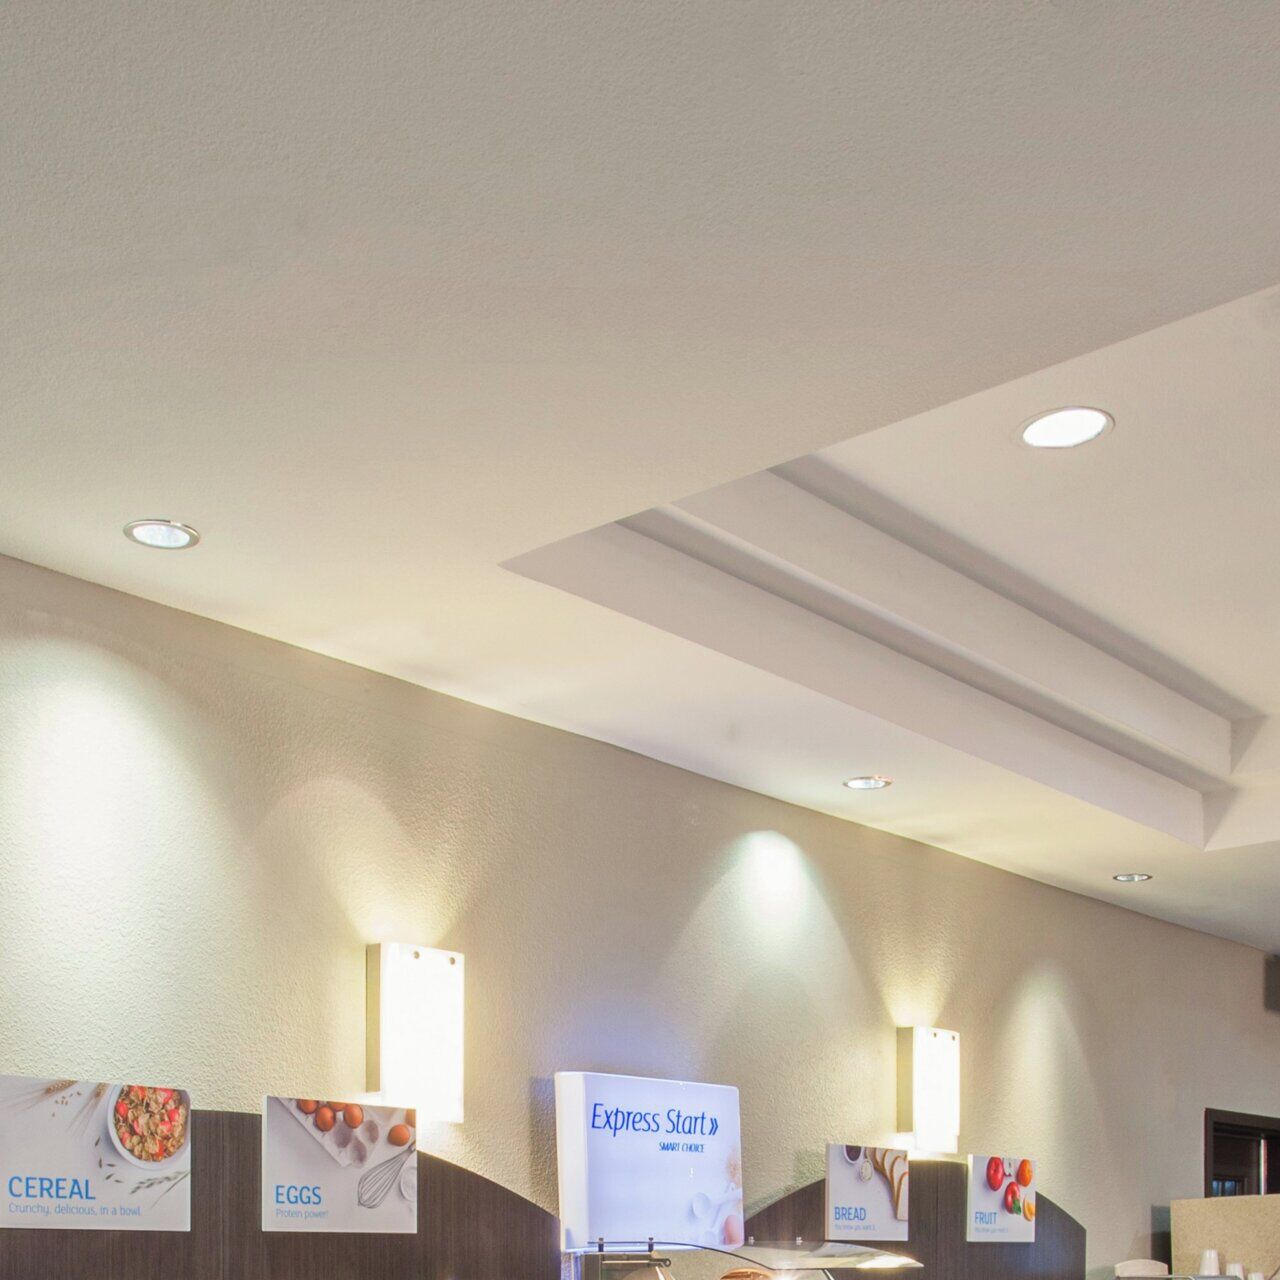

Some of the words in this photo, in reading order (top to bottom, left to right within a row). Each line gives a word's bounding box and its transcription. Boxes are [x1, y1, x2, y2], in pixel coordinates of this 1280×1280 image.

[591, 1102, 661, 1138] Express
[665, 1108, 707, 1136] Start
[658, 1141, 681, 1152] SMART
[681, 1142, 705, 1153] CHOICE
[8, 1175, 97, 1201] CEREAL
[275, 1184, 322, 1205] EGGS
[8, 1202, 53, 1216] Crunchy,
[54, 1203, 98, 1217] delicious,
[99, 1205, 109, 1216] in
[111, 1207, 118, 1216] a
[275, 1208, 303, 1218] Protein
[834, 1205, 867, 1221] BREAD
[974, 1211, 998, 1225] FRUIT
